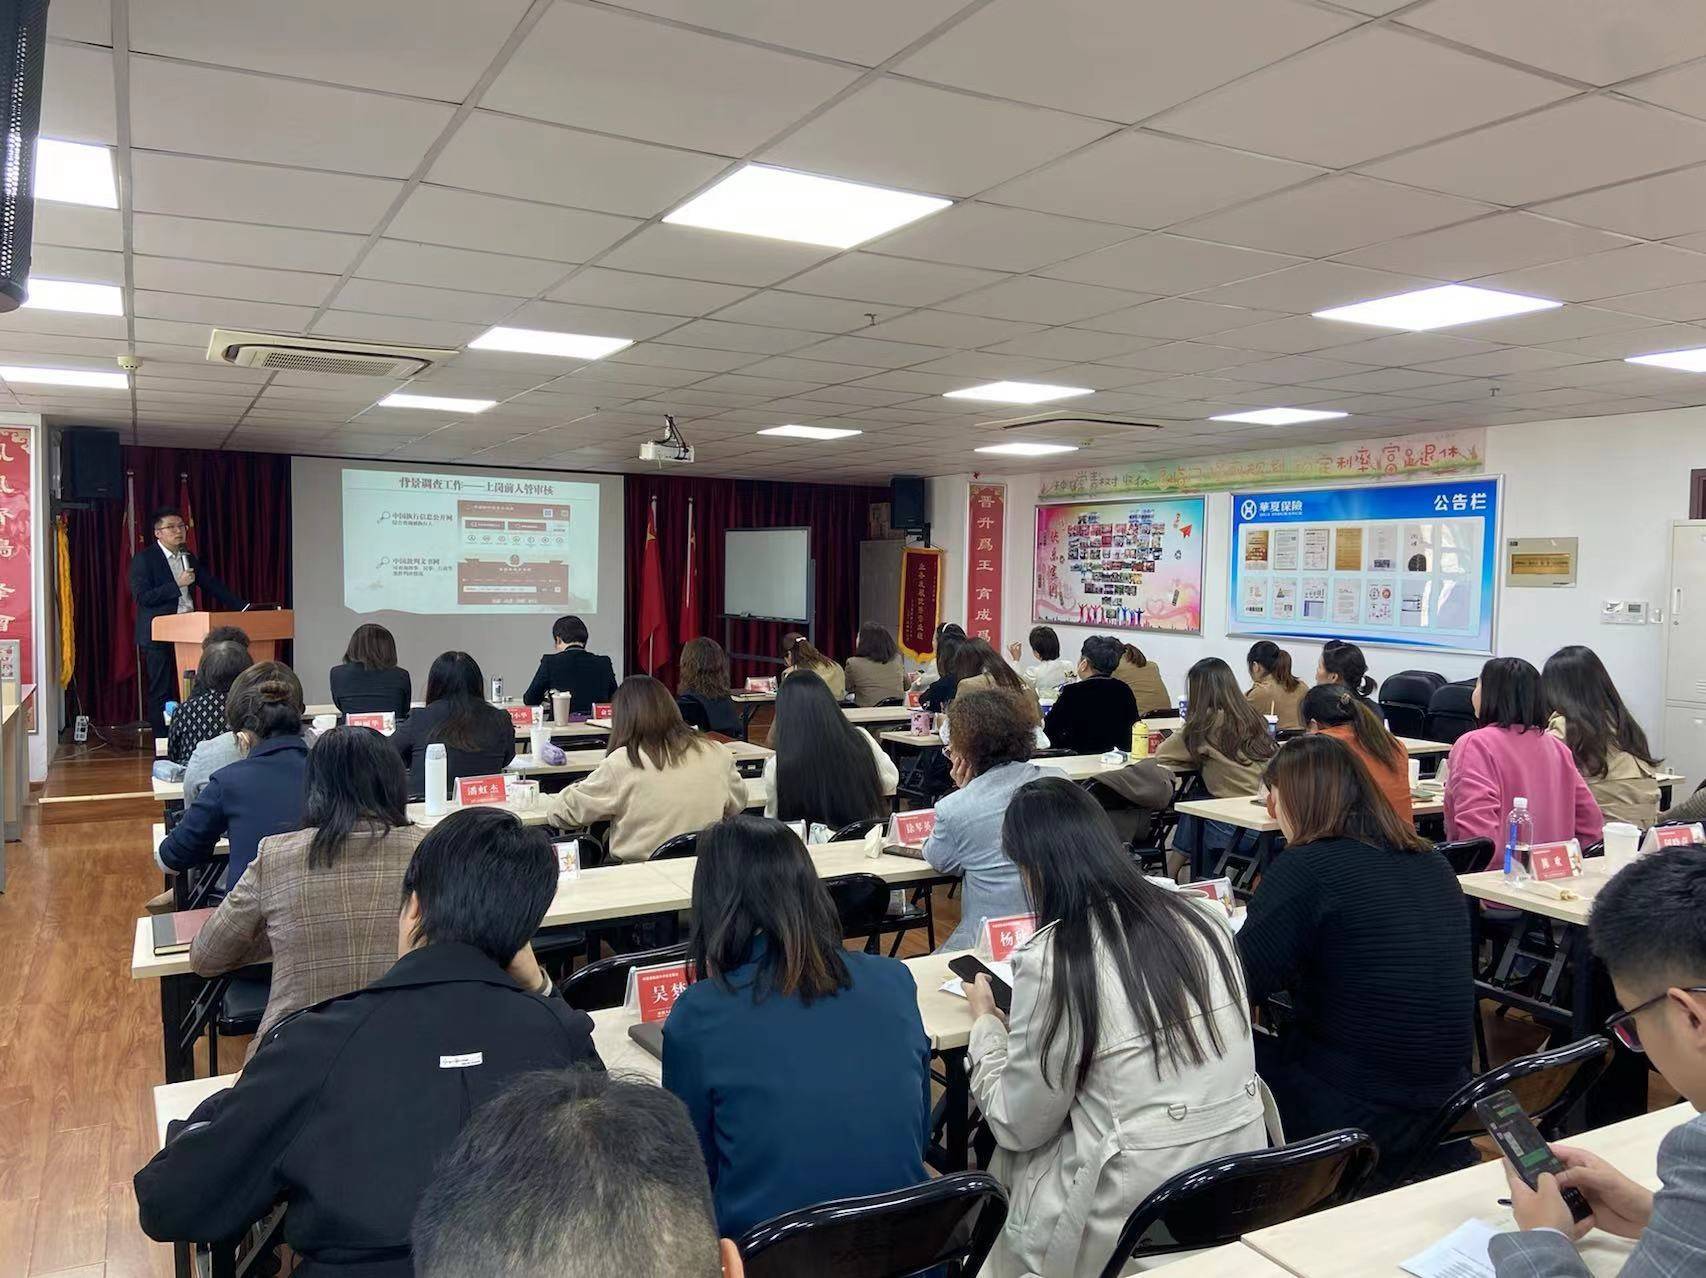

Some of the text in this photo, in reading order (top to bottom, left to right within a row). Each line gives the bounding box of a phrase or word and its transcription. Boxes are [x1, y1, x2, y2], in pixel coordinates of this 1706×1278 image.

[1434, 492, 1487, 511] 公告栏
[467, 783, 499, 796] 潘虹杰
